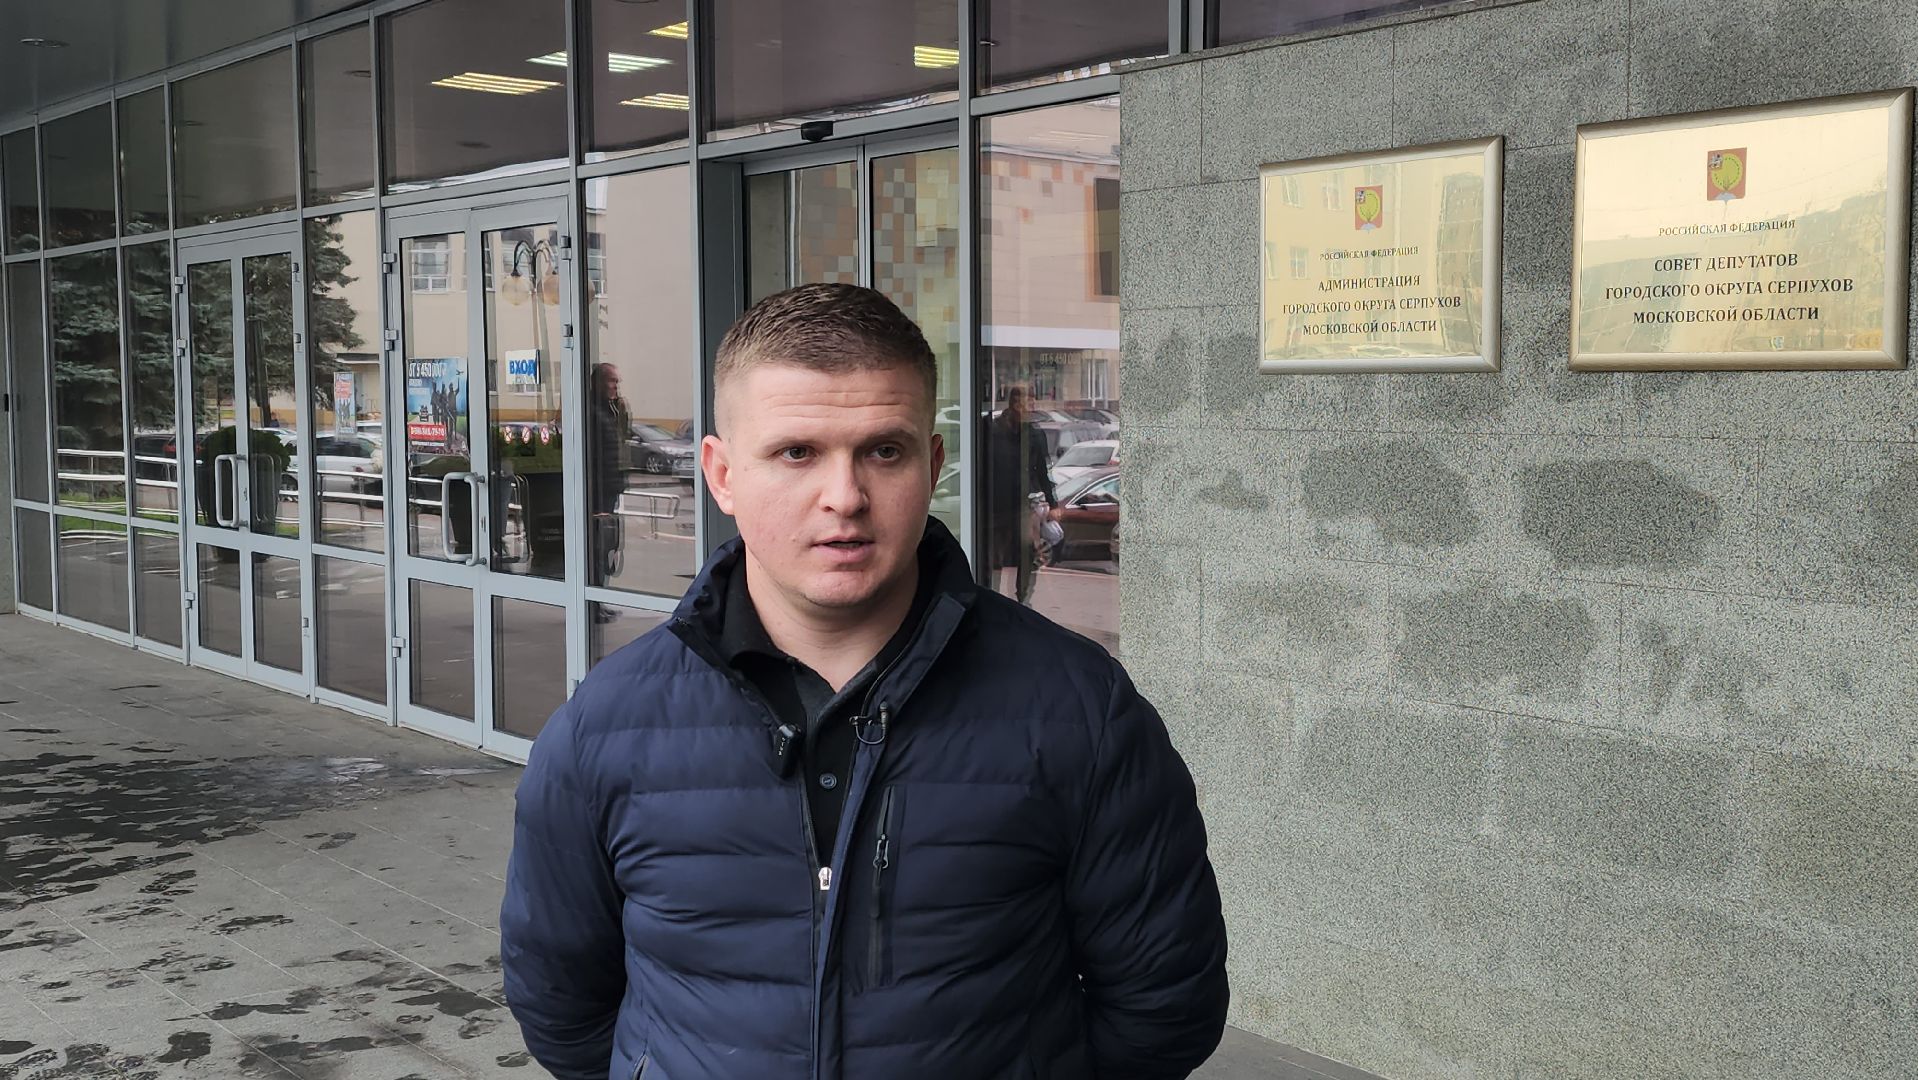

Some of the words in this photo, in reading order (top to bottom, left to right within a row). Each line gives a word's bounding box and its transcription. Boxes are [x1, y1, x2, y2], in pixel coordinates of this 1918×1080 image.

[1659, 223, 1727, 236] РОССИЙСКАЯ
[1729, 219, 1796, 234] ФЕДЕРАЦИЯ
[1319, 248, 1369, 261] РОССИЙСКАЯ
[1370, 245, 1419, 258] ФЕДЕРАЦИЯ
[1654, 257, 1702, 272] СОВЕТ
[1705, 253, 1798, 272] ДЕПУТАТОВ
[1318, 275, 1421, 293] АДМИНИСТРАЦИЯ
[1606, 284, 1700, 301] ГОРОДСКОГО
[1704, 281, 1763, 297] ОКРУГА
[1767, 278, 1854, 295] СЕРПУХОВ
[1283, 301, 1351, 315] ГОРОДСКОГО
[1354, 299, 1396, 312] ОКРУГА
[1399, 296, 1461, 310] СЕРПУХОВ
[1633, 305, 1737, 324] МОСКОВСКОЙ
[1741, 306, 1819, 321] ОБЛАСТИ
[1303, 319, 1378, 336] МОСКОВСКОЙ
[1382, 320, 1437, 334] ОБЛАСТИ
[509, 359, 537, 376] ВХОД
